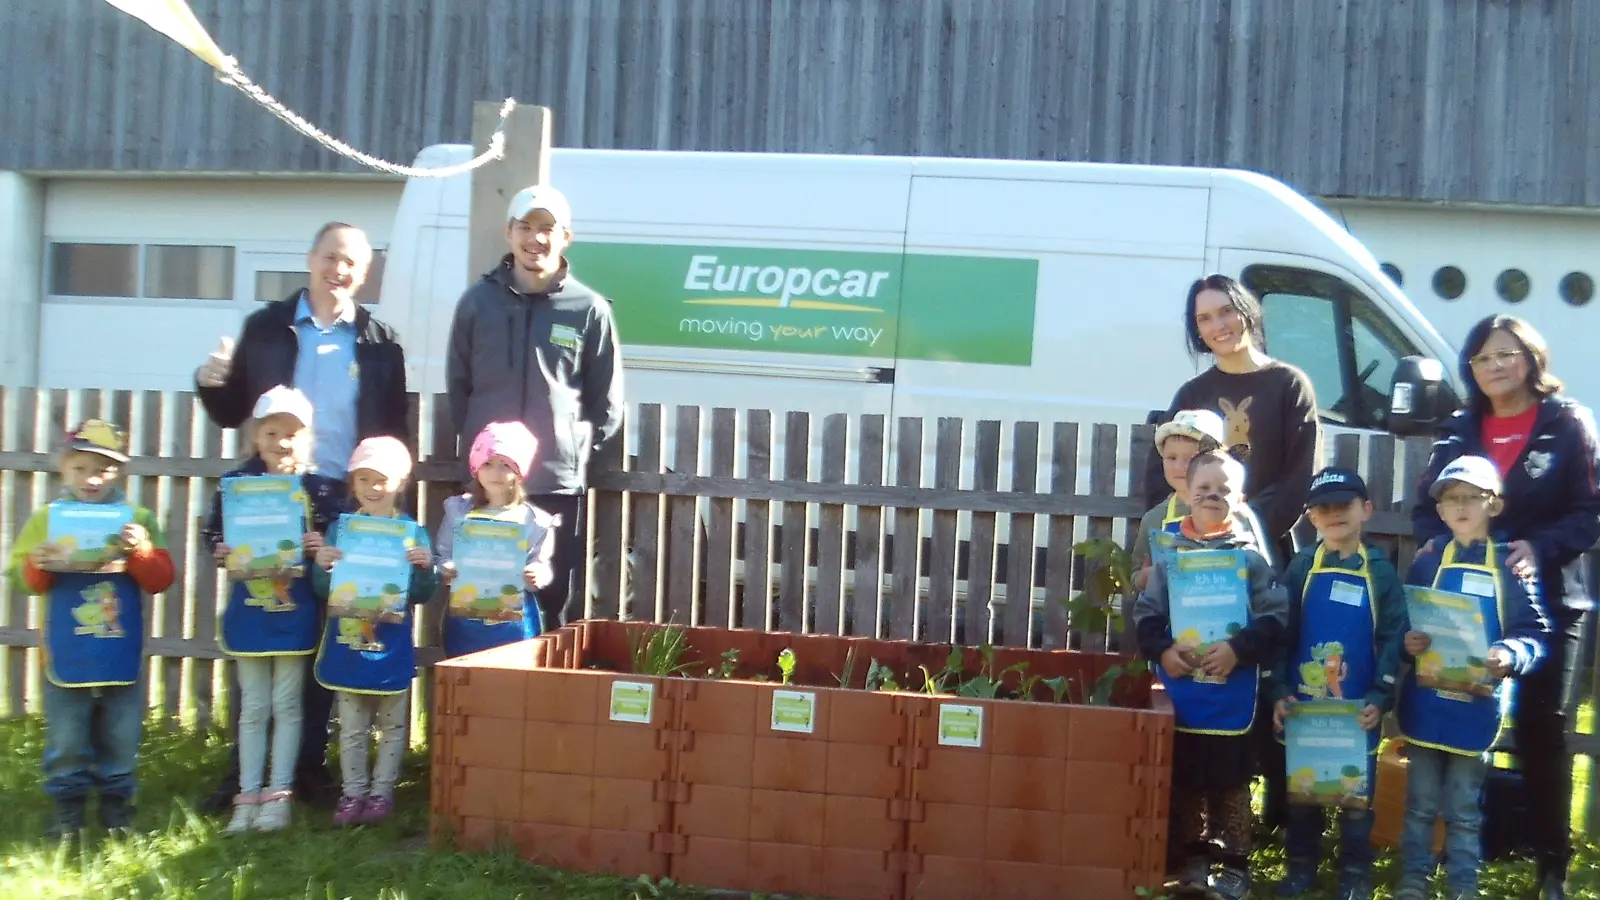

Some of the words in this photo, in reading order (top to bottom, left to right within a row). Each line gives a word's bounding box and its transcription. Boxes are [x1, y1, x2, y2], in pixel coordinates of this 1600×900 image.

[684, 254, 889, 308] Europcar
[679, 317, 763, 341] moving
[769, 323, 827, 341] your
[831, 324, 883, 347] way
